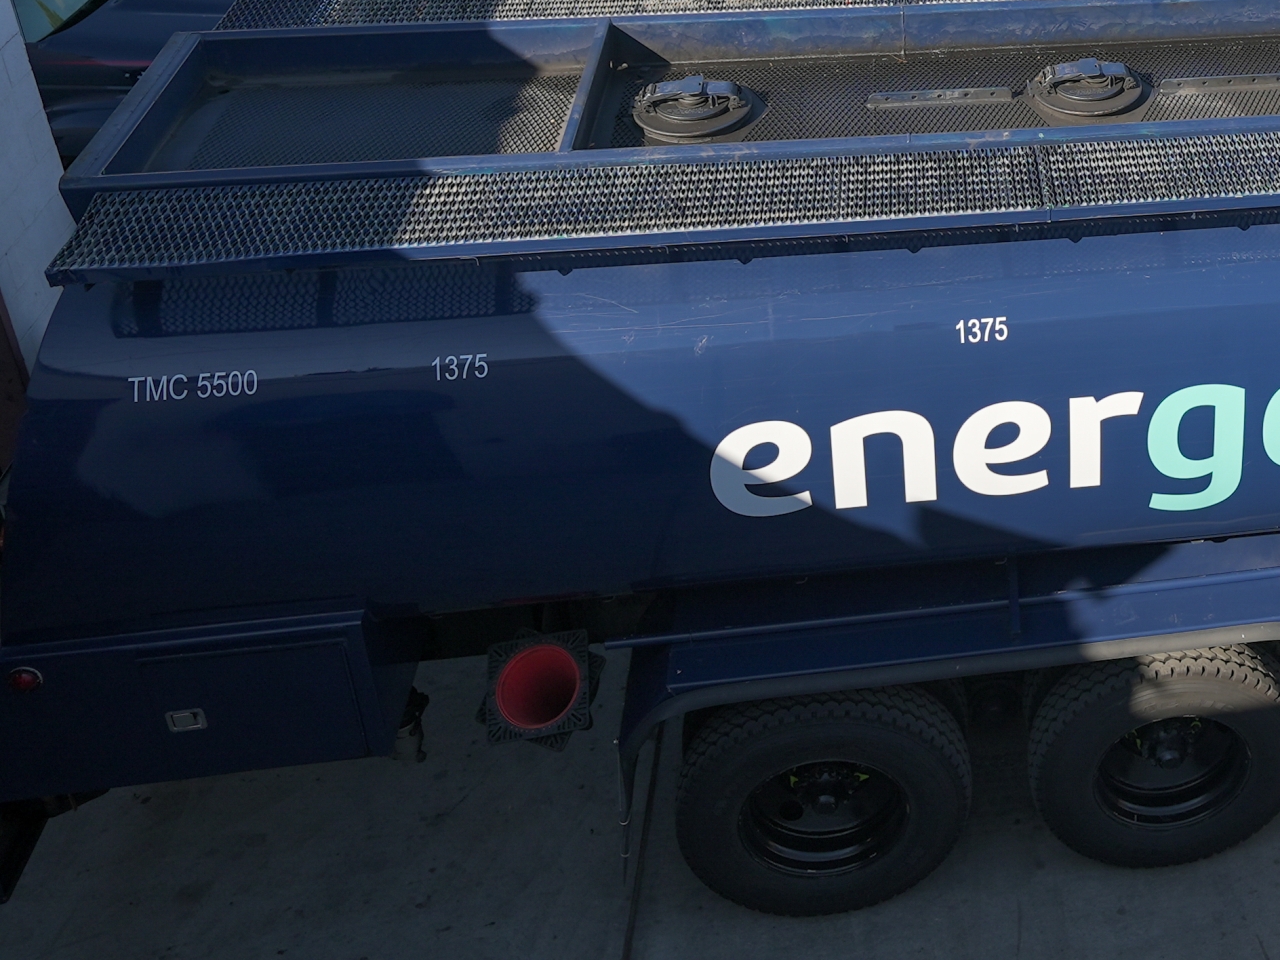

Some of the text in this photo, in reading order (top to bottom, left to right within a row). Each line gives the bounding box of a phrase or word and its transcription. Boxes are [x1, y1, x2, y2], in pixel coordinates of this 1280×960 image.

[955, 315, 1009, 345] 1375
[430, 353, 489, 381] 1375
[128, 369, 259, 403] TMC 5500
